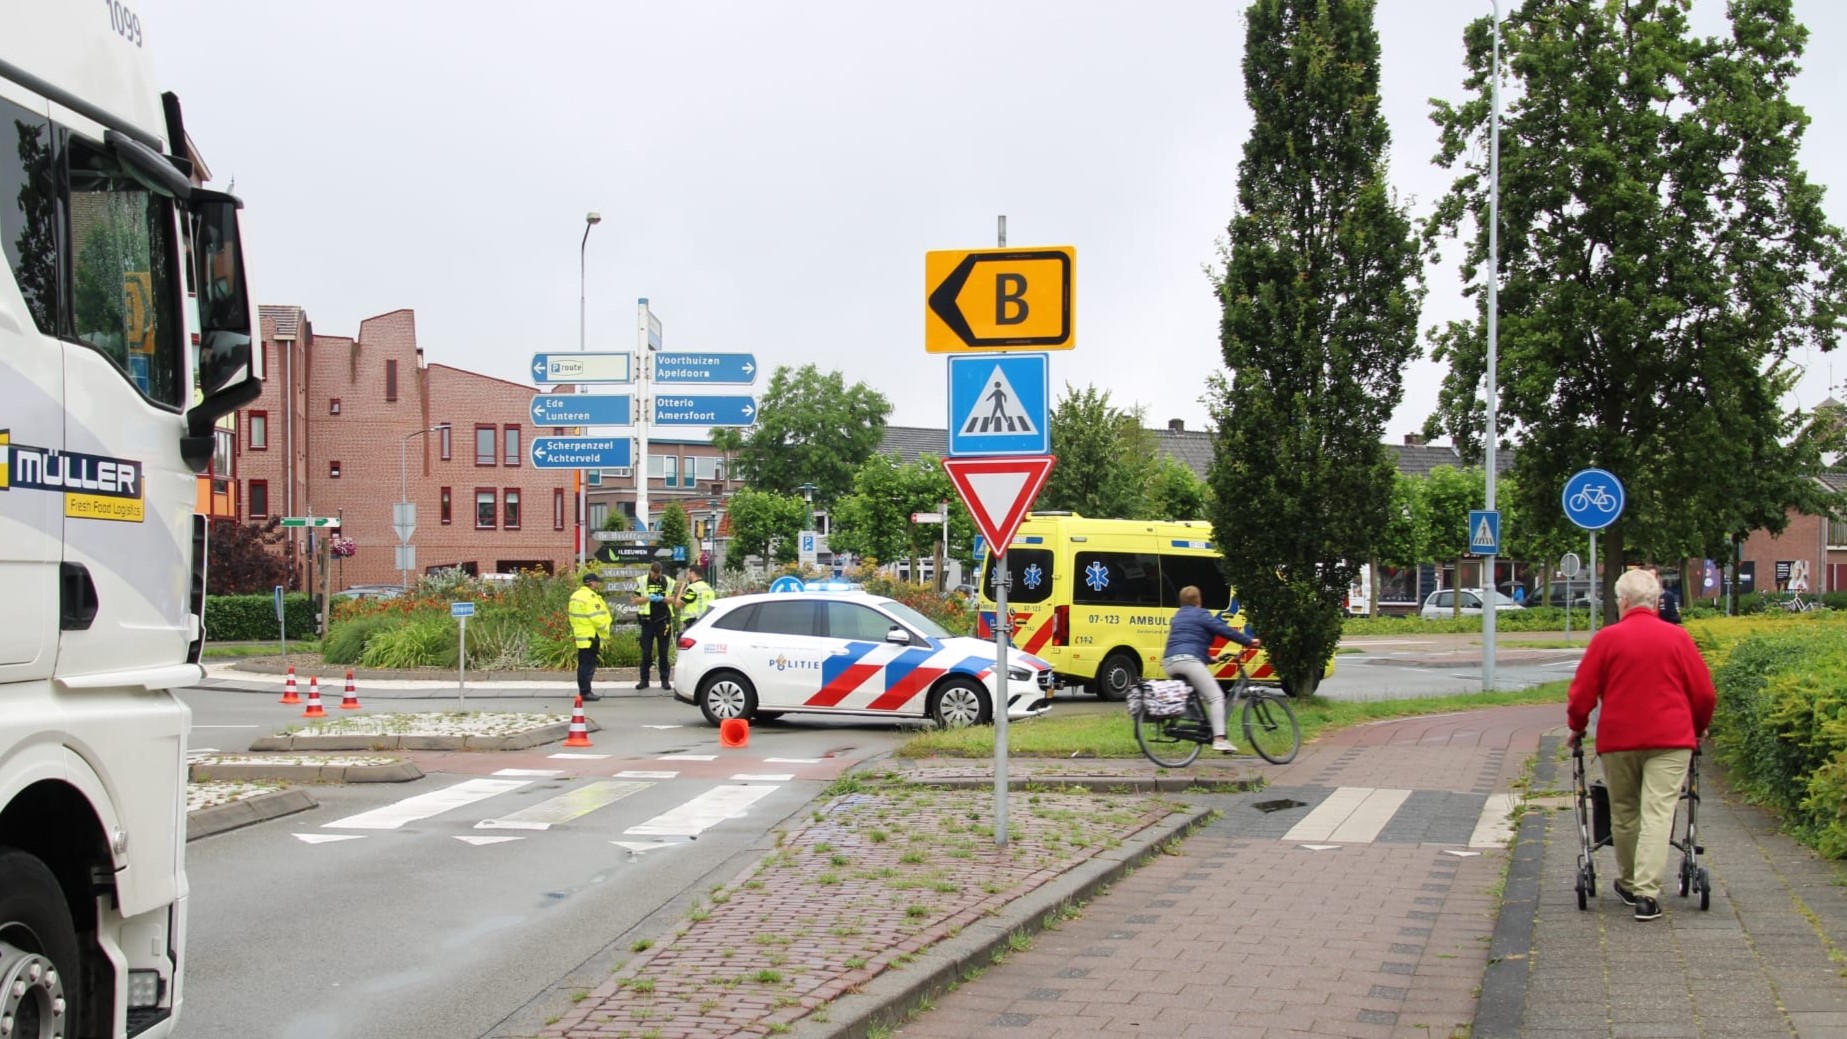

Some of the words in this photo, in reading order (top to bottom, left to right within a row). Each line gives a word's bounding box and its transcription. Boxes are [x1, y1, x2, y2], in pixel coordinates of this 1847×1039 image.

[105, 0, 142, 48] 1099
[995, 273, 1029, 326] B
[657, 356, 720, 365] Voorthuizen
[546, 399, 564, 408] Ede
[657, 398, 694, 407] Otterlo
[546, 412, 590, 421] Lunteren
[657, 411, 716, 420] Amersfoort
[547, 441, 613, 452] Scherpenzeel
[547, 453, 601, 463] Achterveld
[17, 448, 135, 494] MÜLLER
[70, 498, 91, 512] Fresh
[93, 500, 112, 514] Food
[112, 502, 141, 518] Logistics
[1088, 614, 1120, 624] 07-123
[769, 656, 821, 672] POLITIE
